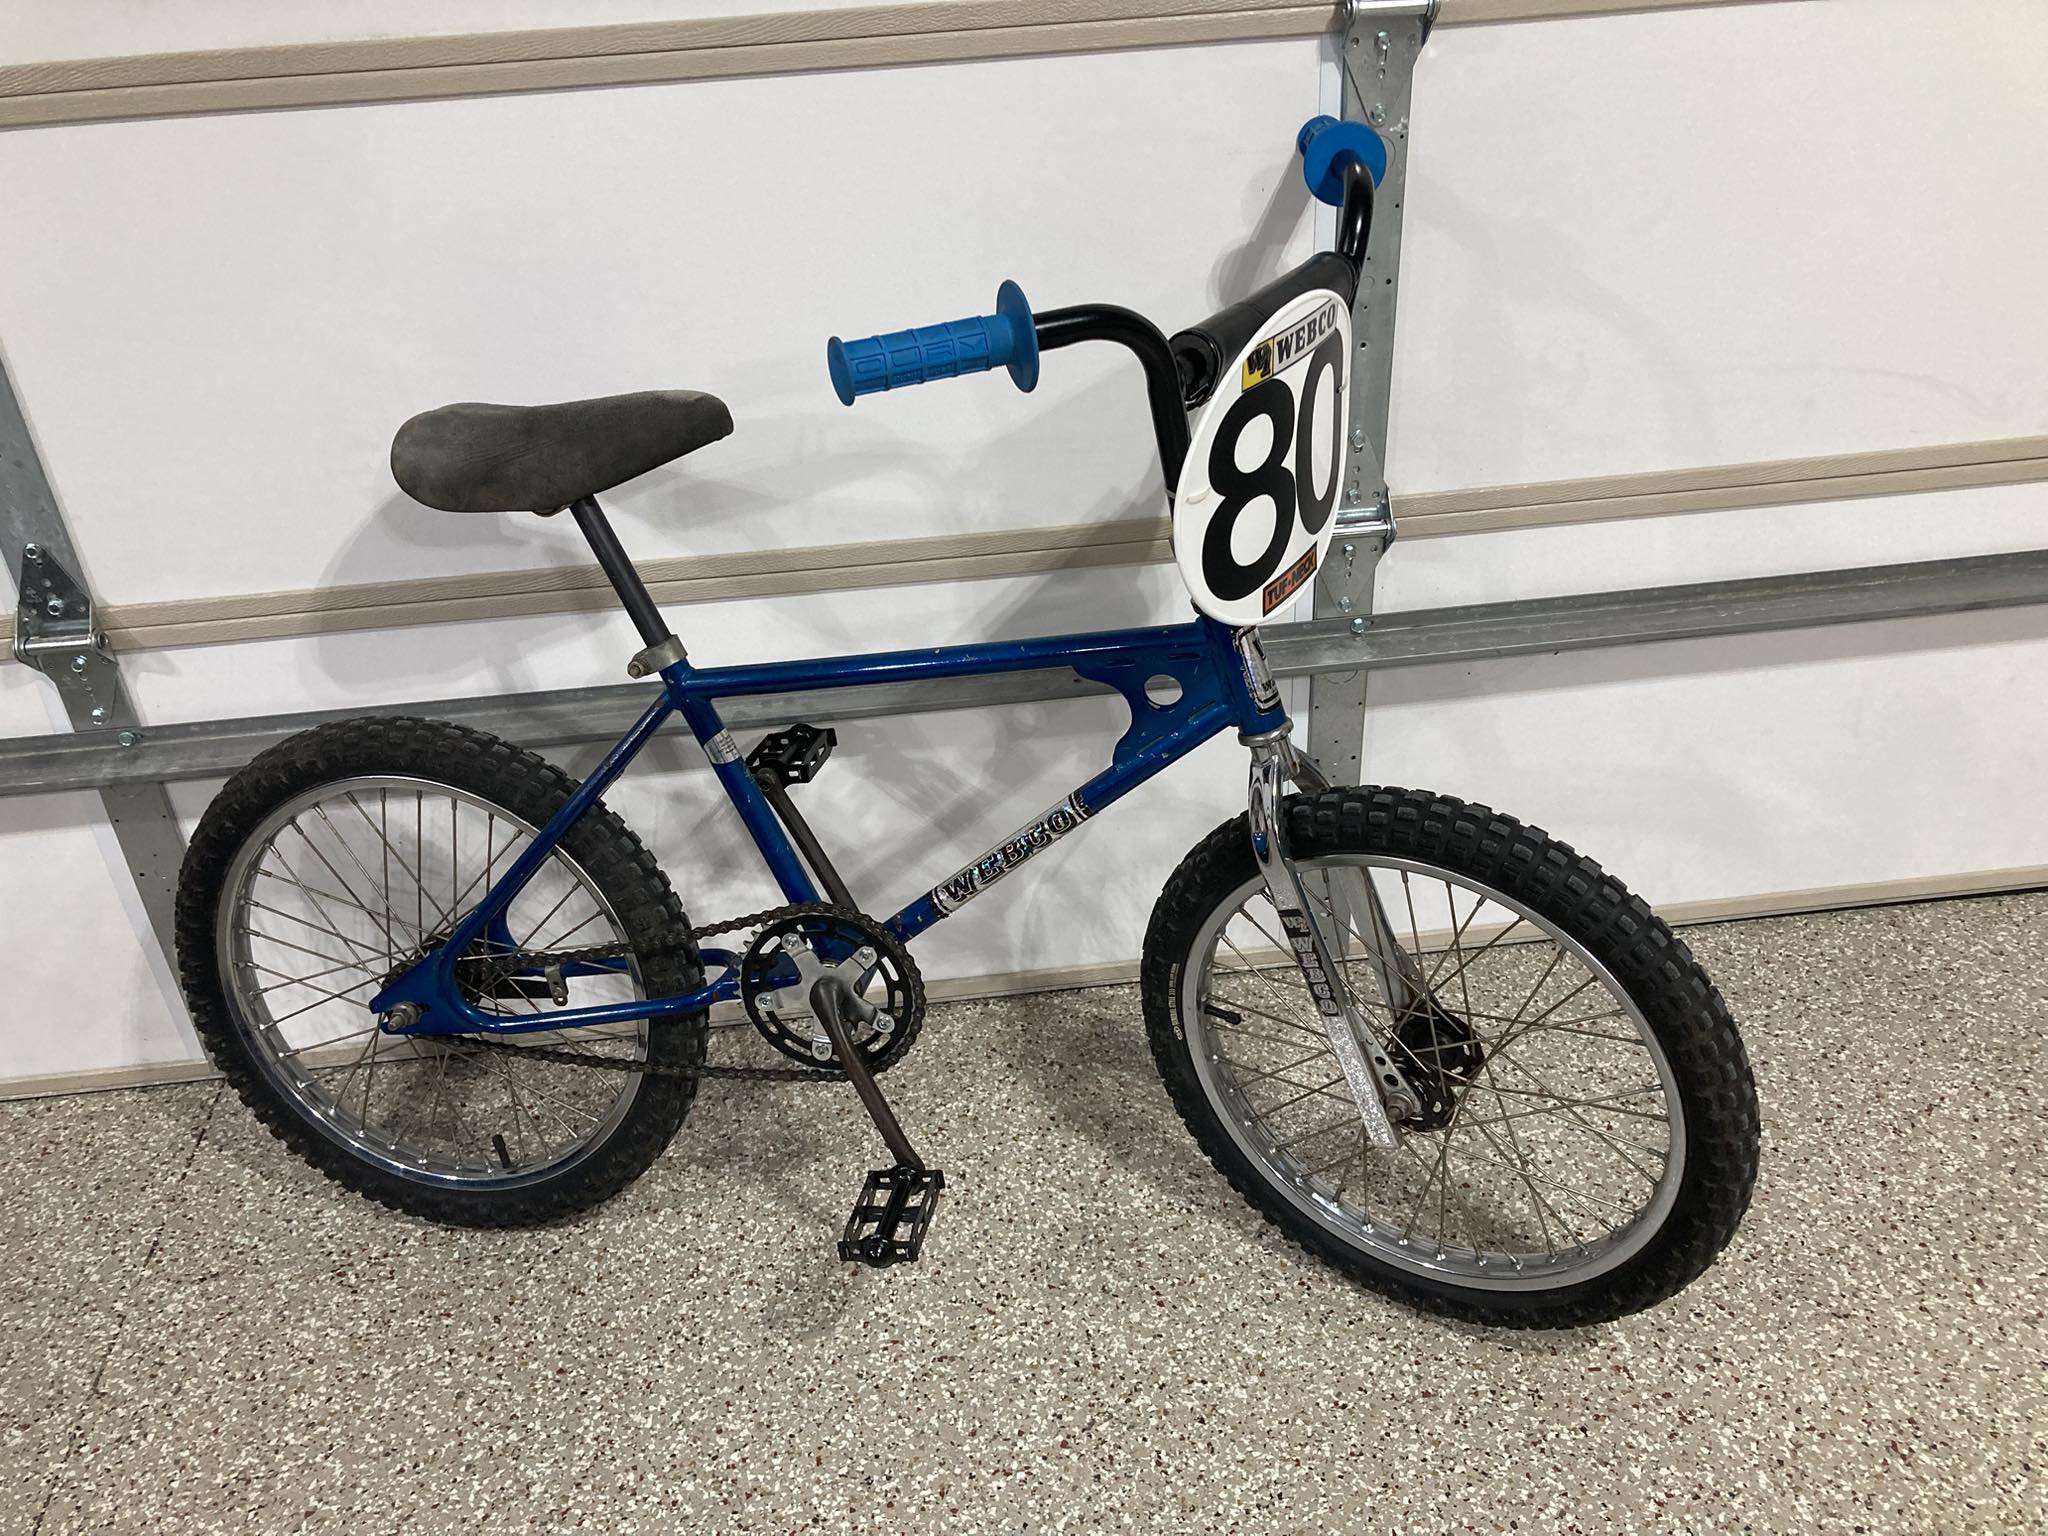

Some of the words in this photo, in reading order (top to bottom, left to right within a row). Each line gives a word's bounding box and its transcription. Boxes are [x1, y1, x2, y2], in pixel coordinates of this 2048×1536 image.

[1276, 303, 1336, 365] WEBCO
[1201, 328, 1344, 602] 80
[943, 809, 1078, 903] WEBCO
[1290, 934, 1339, 1014] WEBCO
